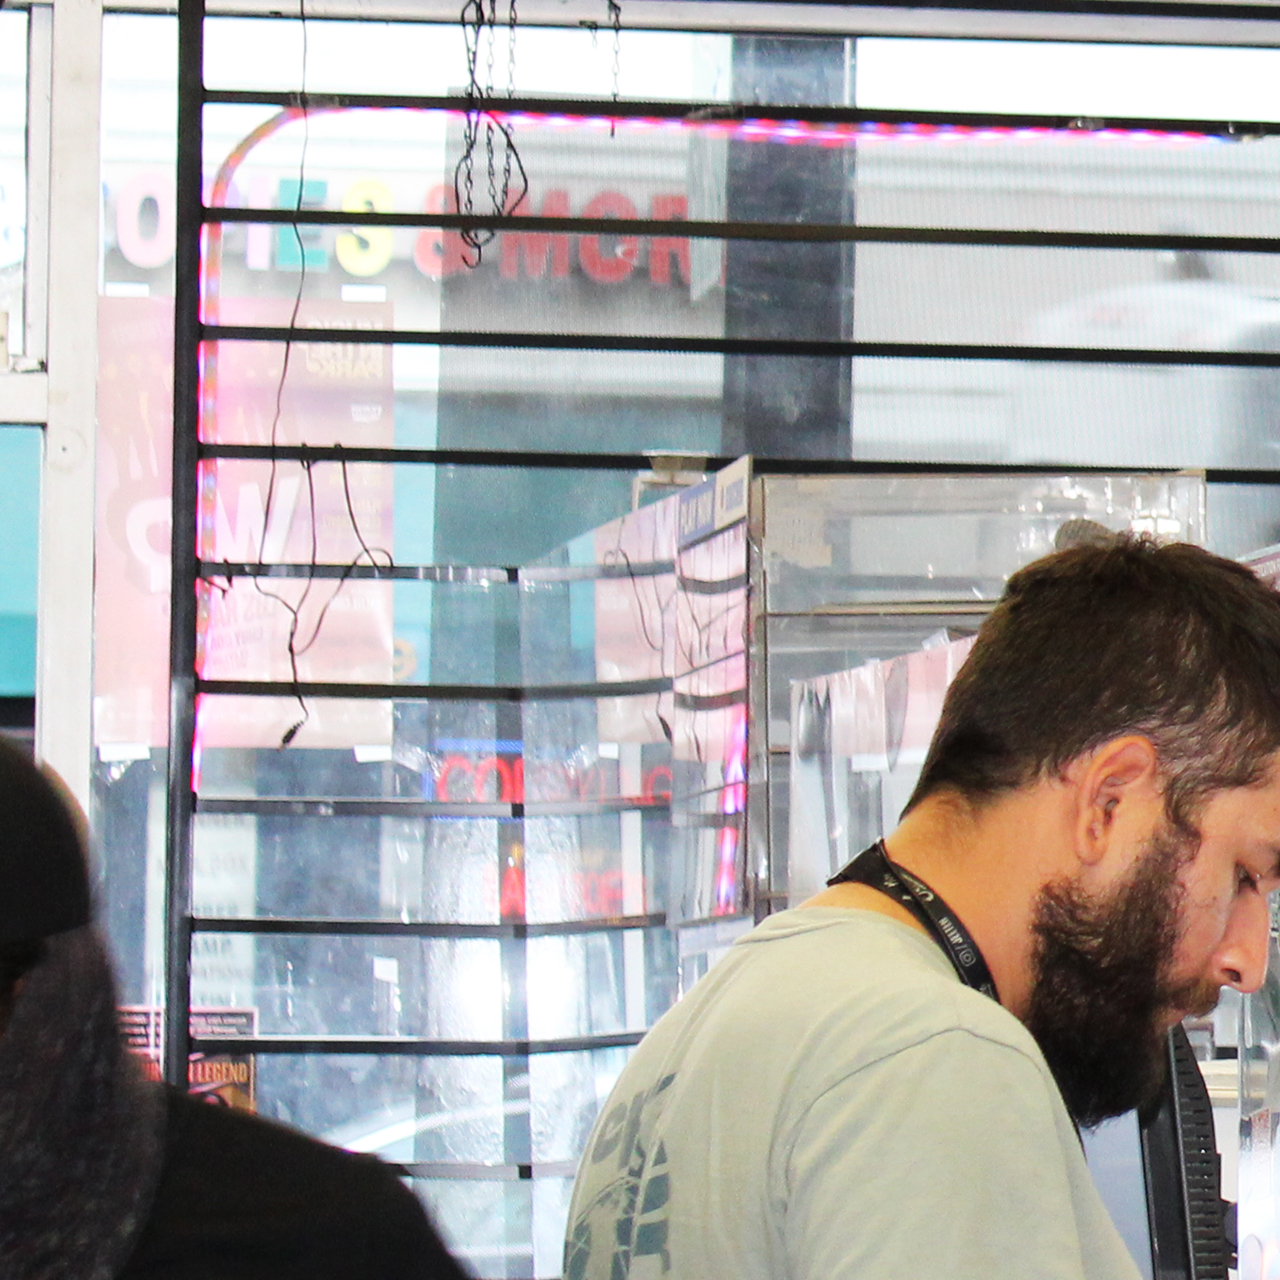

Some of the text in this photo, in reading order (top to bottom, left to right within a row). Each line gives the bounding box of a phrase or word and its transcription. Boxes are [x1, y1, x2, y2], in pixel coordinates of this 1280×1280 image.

[413, 184, 700, 286] & MOR
[198, 1061, 250, 1083] LEGEND
